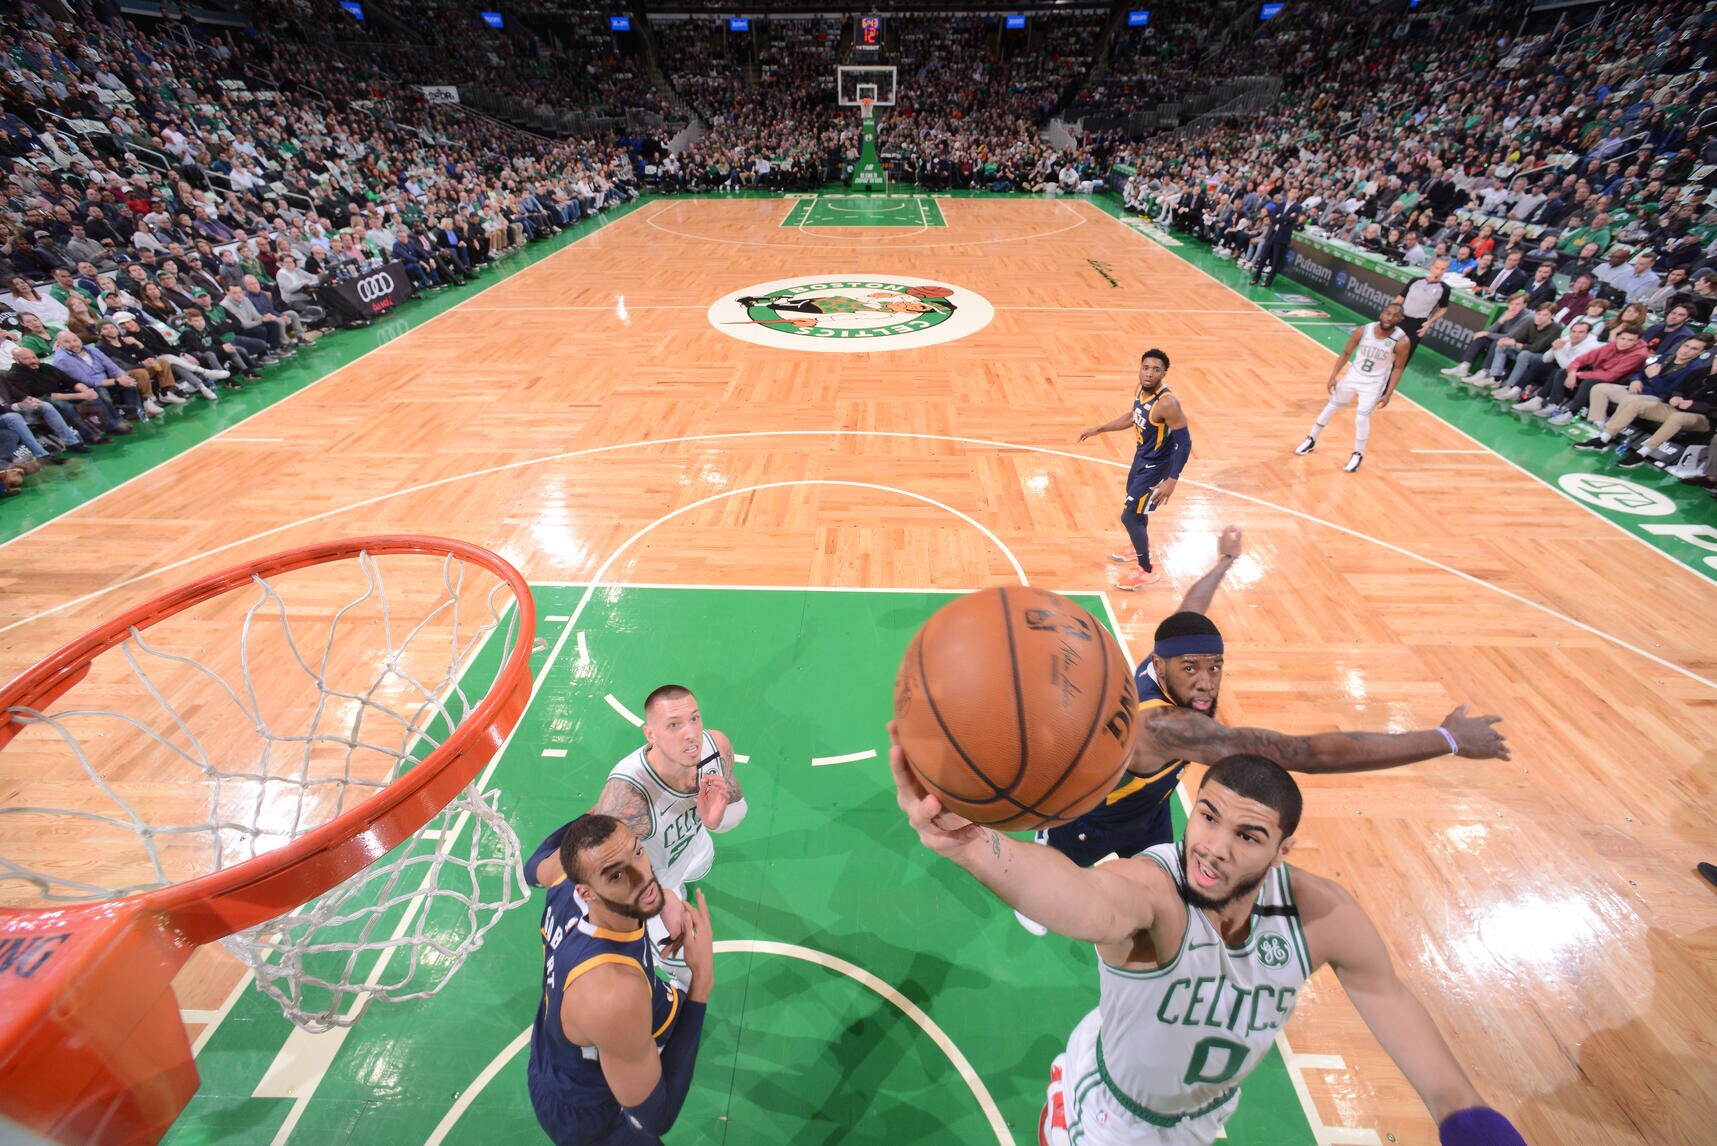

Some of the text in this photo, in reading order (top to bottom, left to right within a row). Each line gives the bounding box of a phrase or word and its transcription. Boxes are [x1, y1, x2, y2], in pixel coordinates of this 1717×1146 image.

[864, 28, 876, 44] 12
[1294, 253, 1332, 281] Putnam
[787, 281, 904, 294] BOSTON
[795, 320, 930, 338] CELTICS
[1361, 358, 1375, 373] 8
[1183, 1036, 1251, 1086] 0
